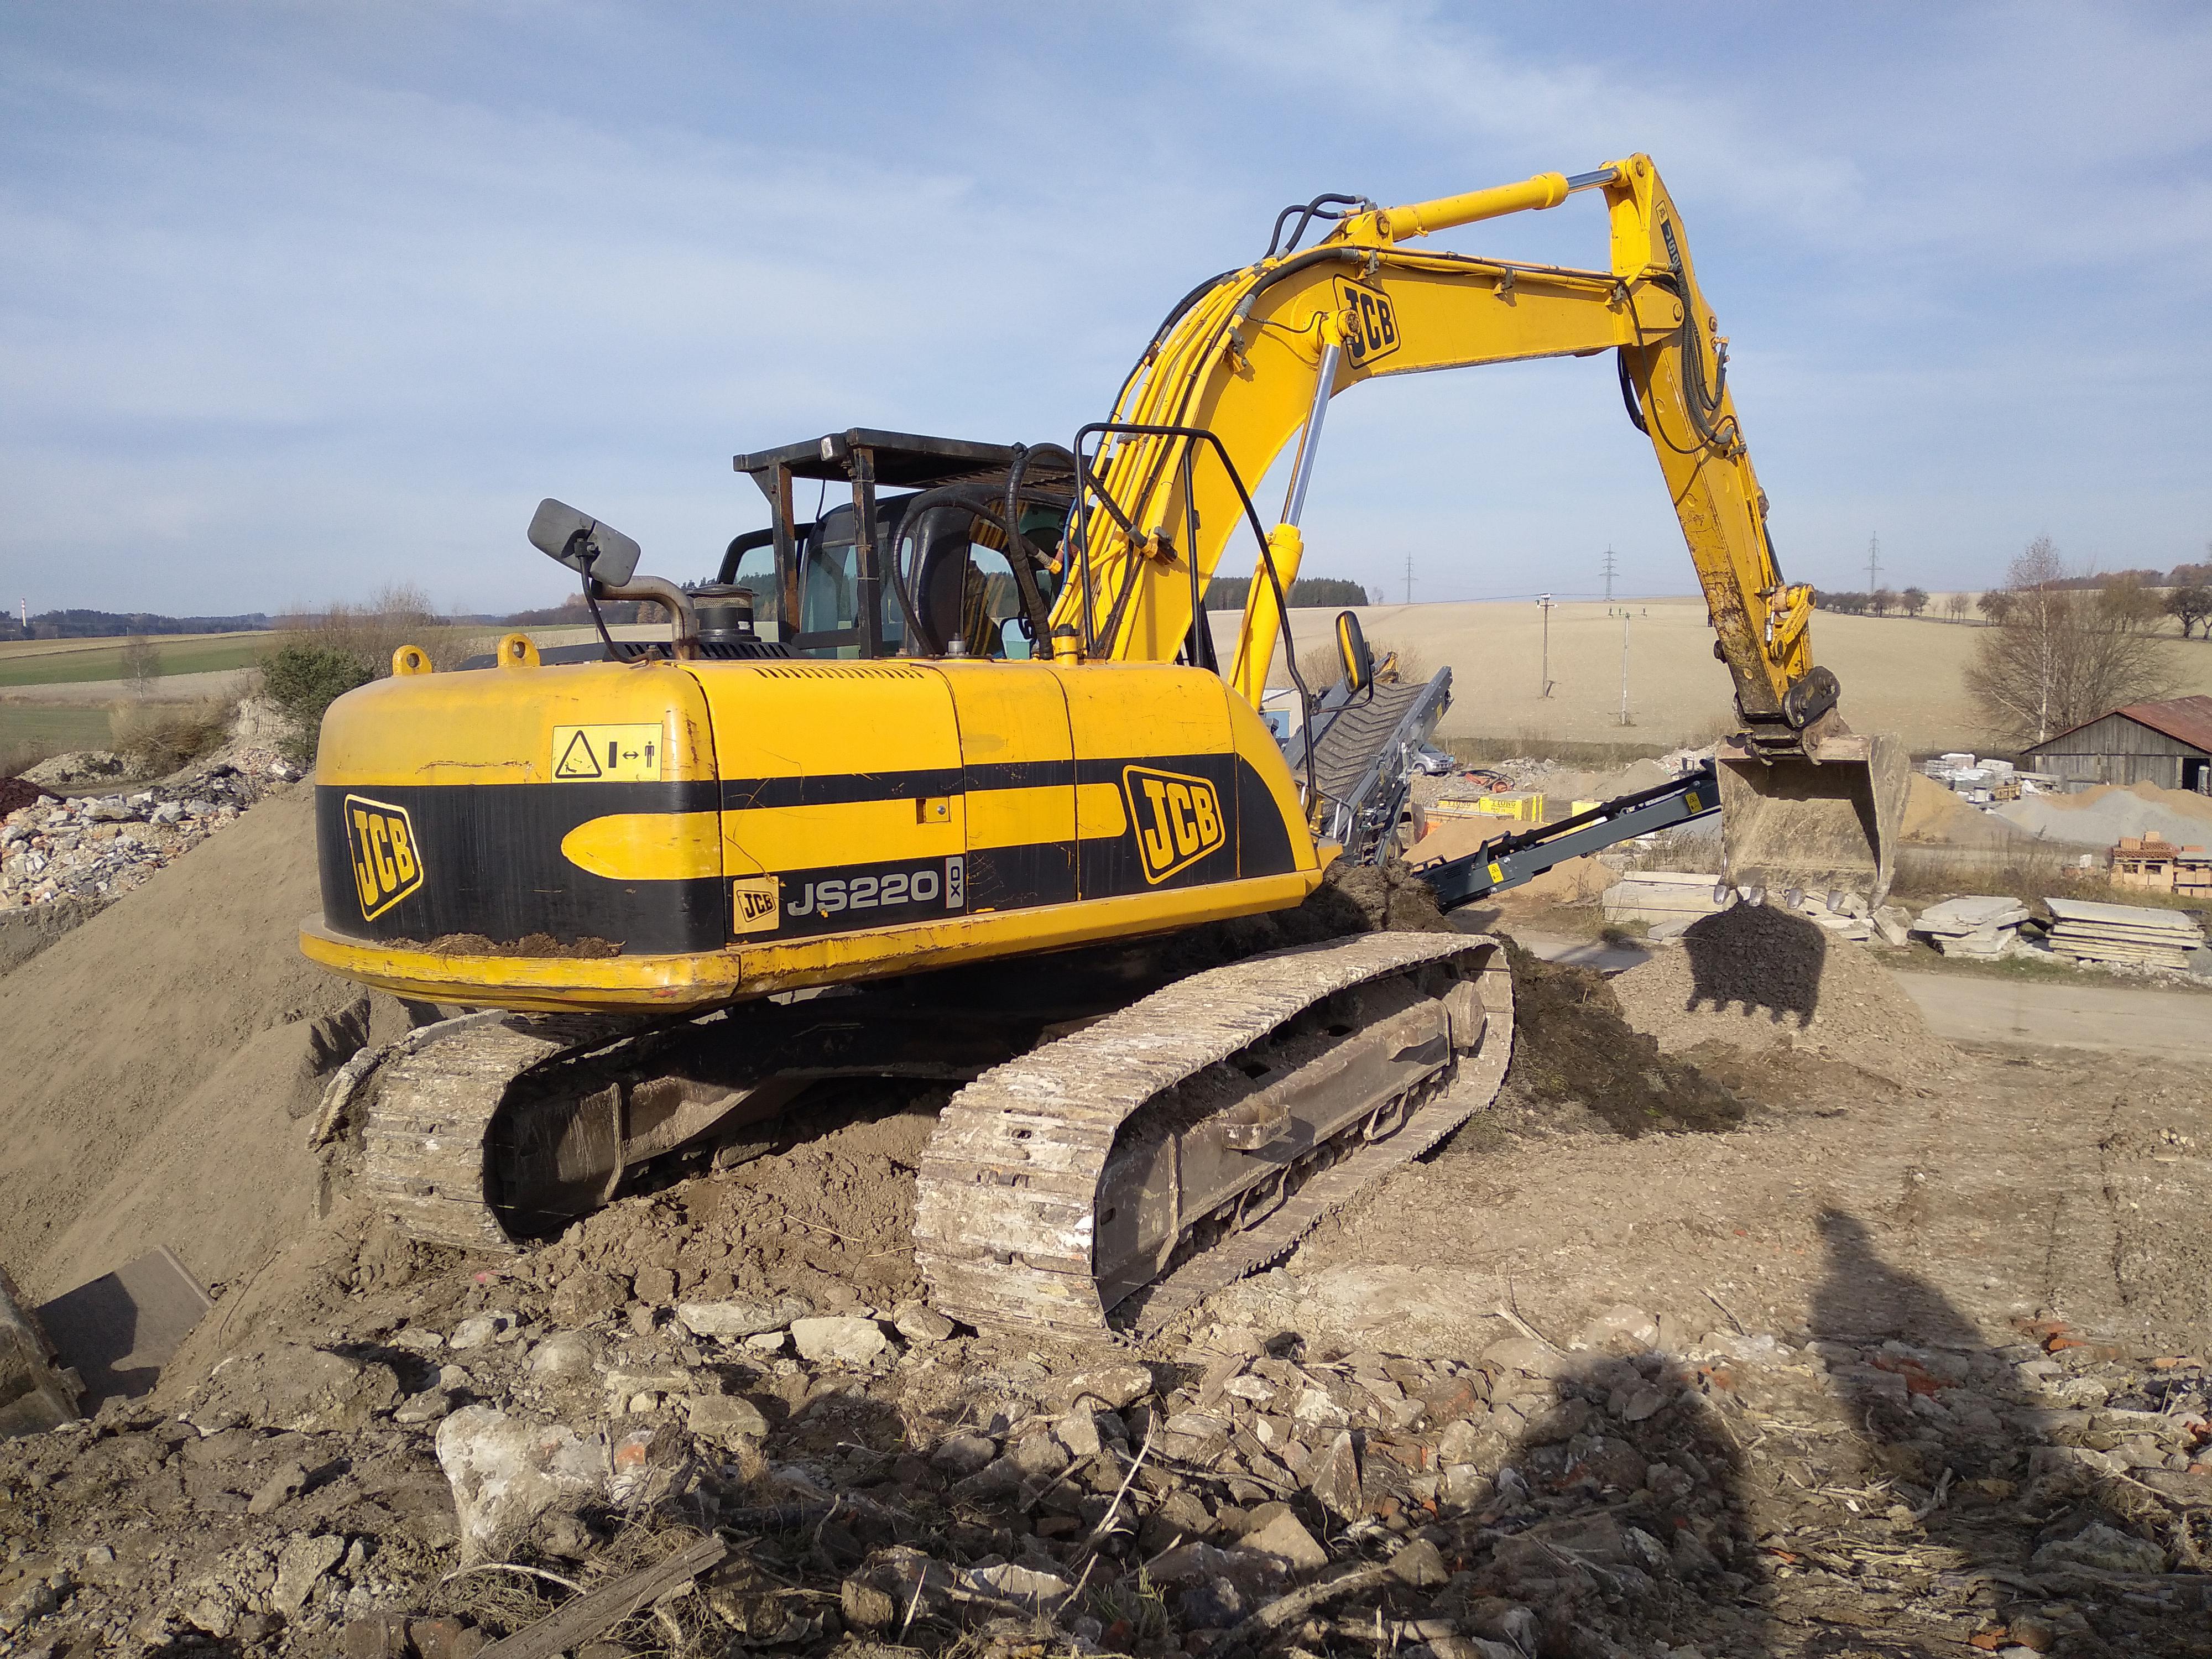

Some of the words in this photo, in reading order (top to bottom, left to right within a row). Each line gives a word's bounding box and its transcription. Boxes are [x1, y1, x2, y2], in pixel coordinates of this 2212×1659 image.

[1344, 286, 1395, 357] JCB
[1142, 779, 1218, 869] JCB
[353, 809, 415, 906] JCB
[950, 865, 961, 899] XD
[743, 893, 774, 919] JCB
[787, 870, 938, 916] JS220
